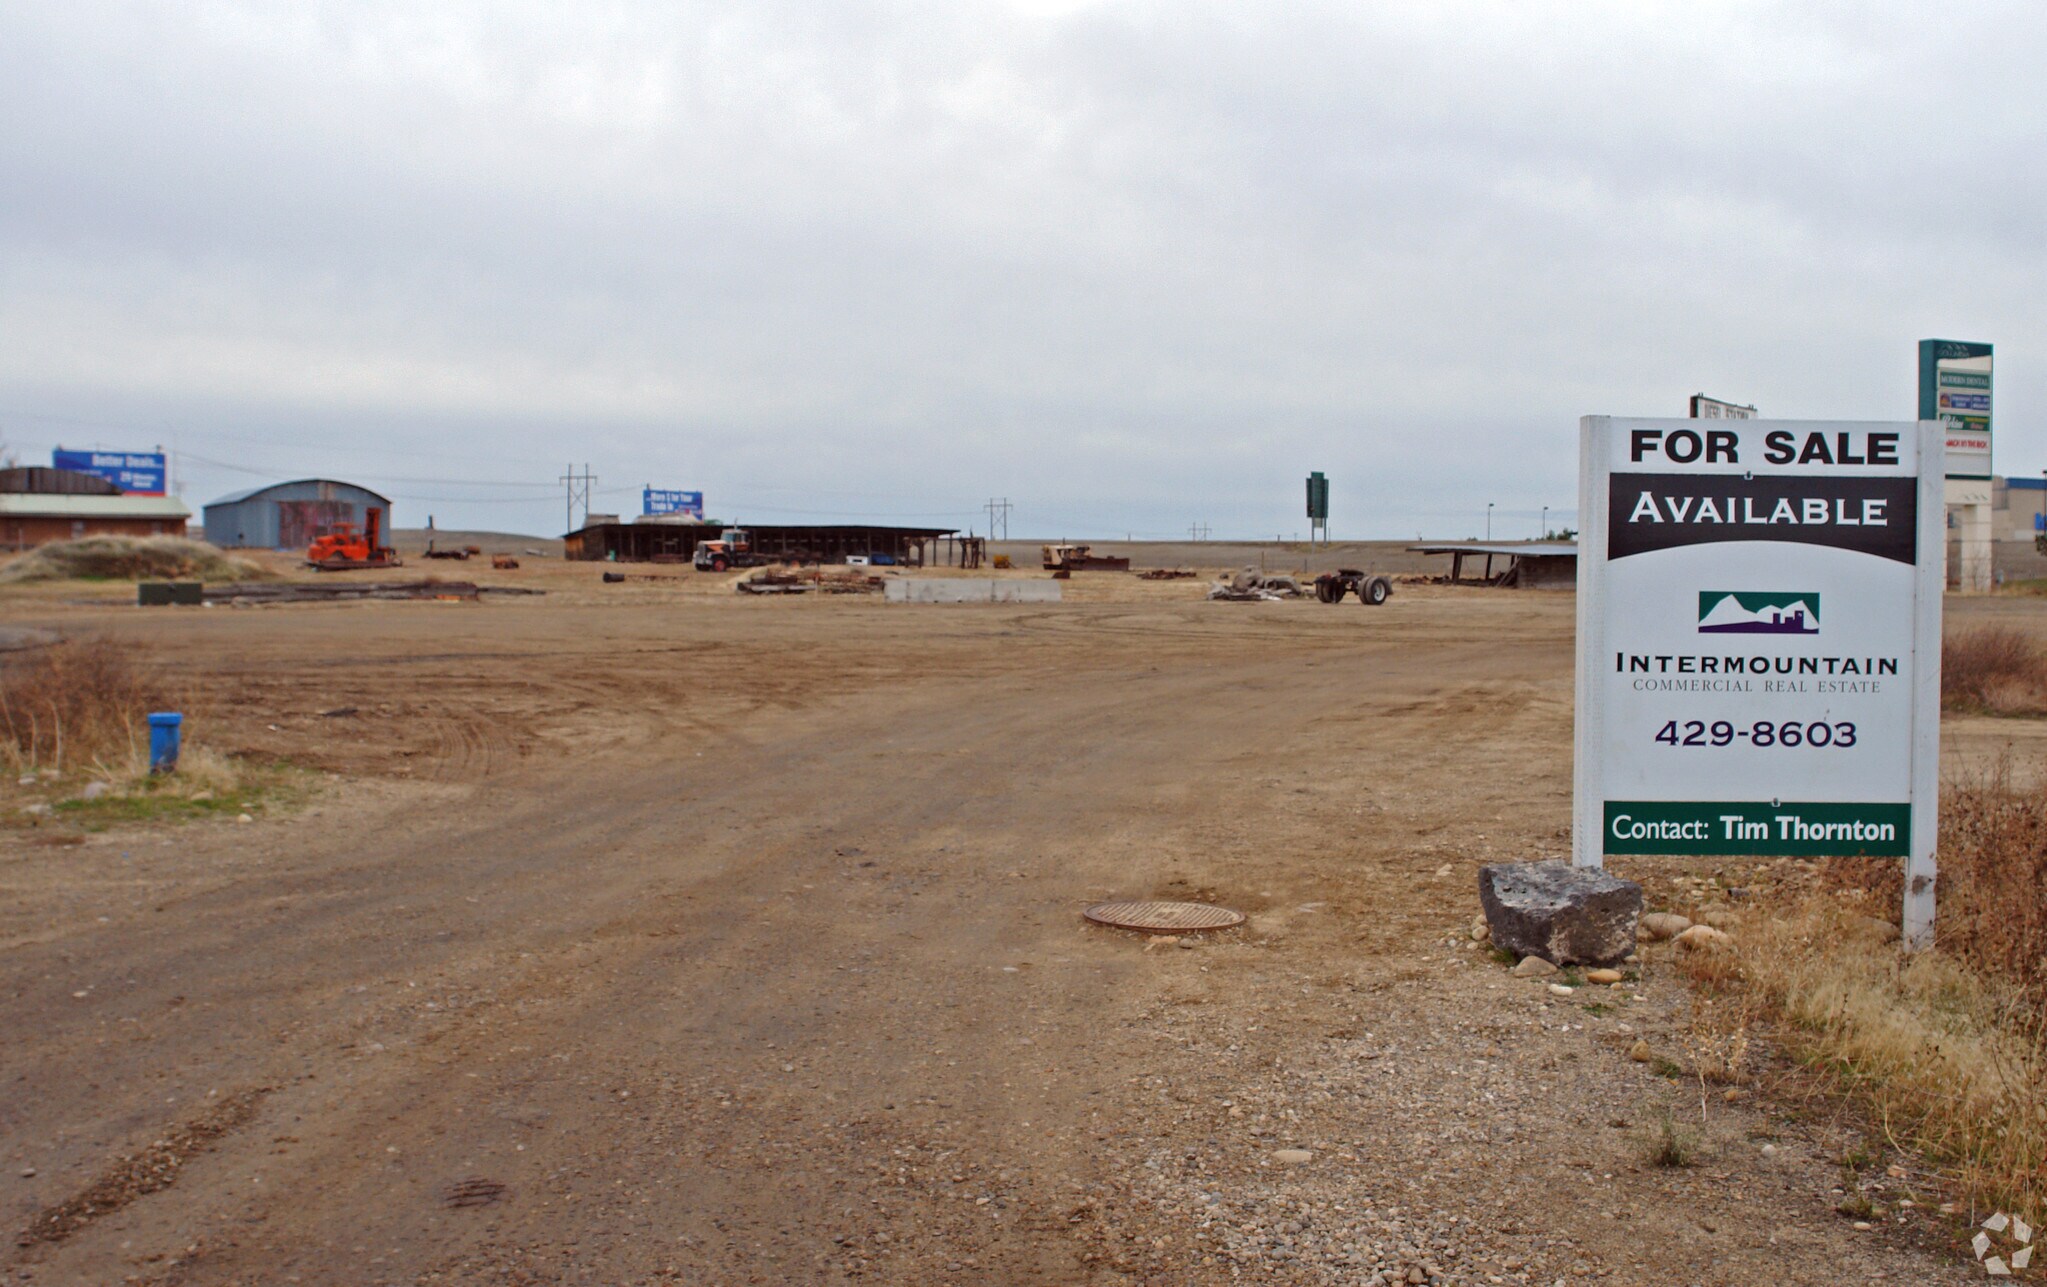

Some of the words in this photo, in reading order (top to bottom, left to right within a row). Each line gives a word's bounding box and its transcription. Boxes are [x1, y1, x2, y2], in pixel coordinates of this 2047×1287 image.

[1631, 430, 1740, 463] FOR
[1764, 431, 1900, 465] SALE
[1628, 491, 1888, 527] AVAILABLE
[1616, 652, 1898, 675] INTERMOUNTAIN
[1633, 679, 1753, 692] COMMERCIAL
[1765, 680, 1808, 693] REAL
[1818, 681, 1881, 693] ESTATE
[1655, 720, 1857, 747] 429-8603
[1612, 815, 1709, 840] Contact:
[1719, 815, 1768, 840] Tim
[1775, 815, 1895, 841] Thornton
